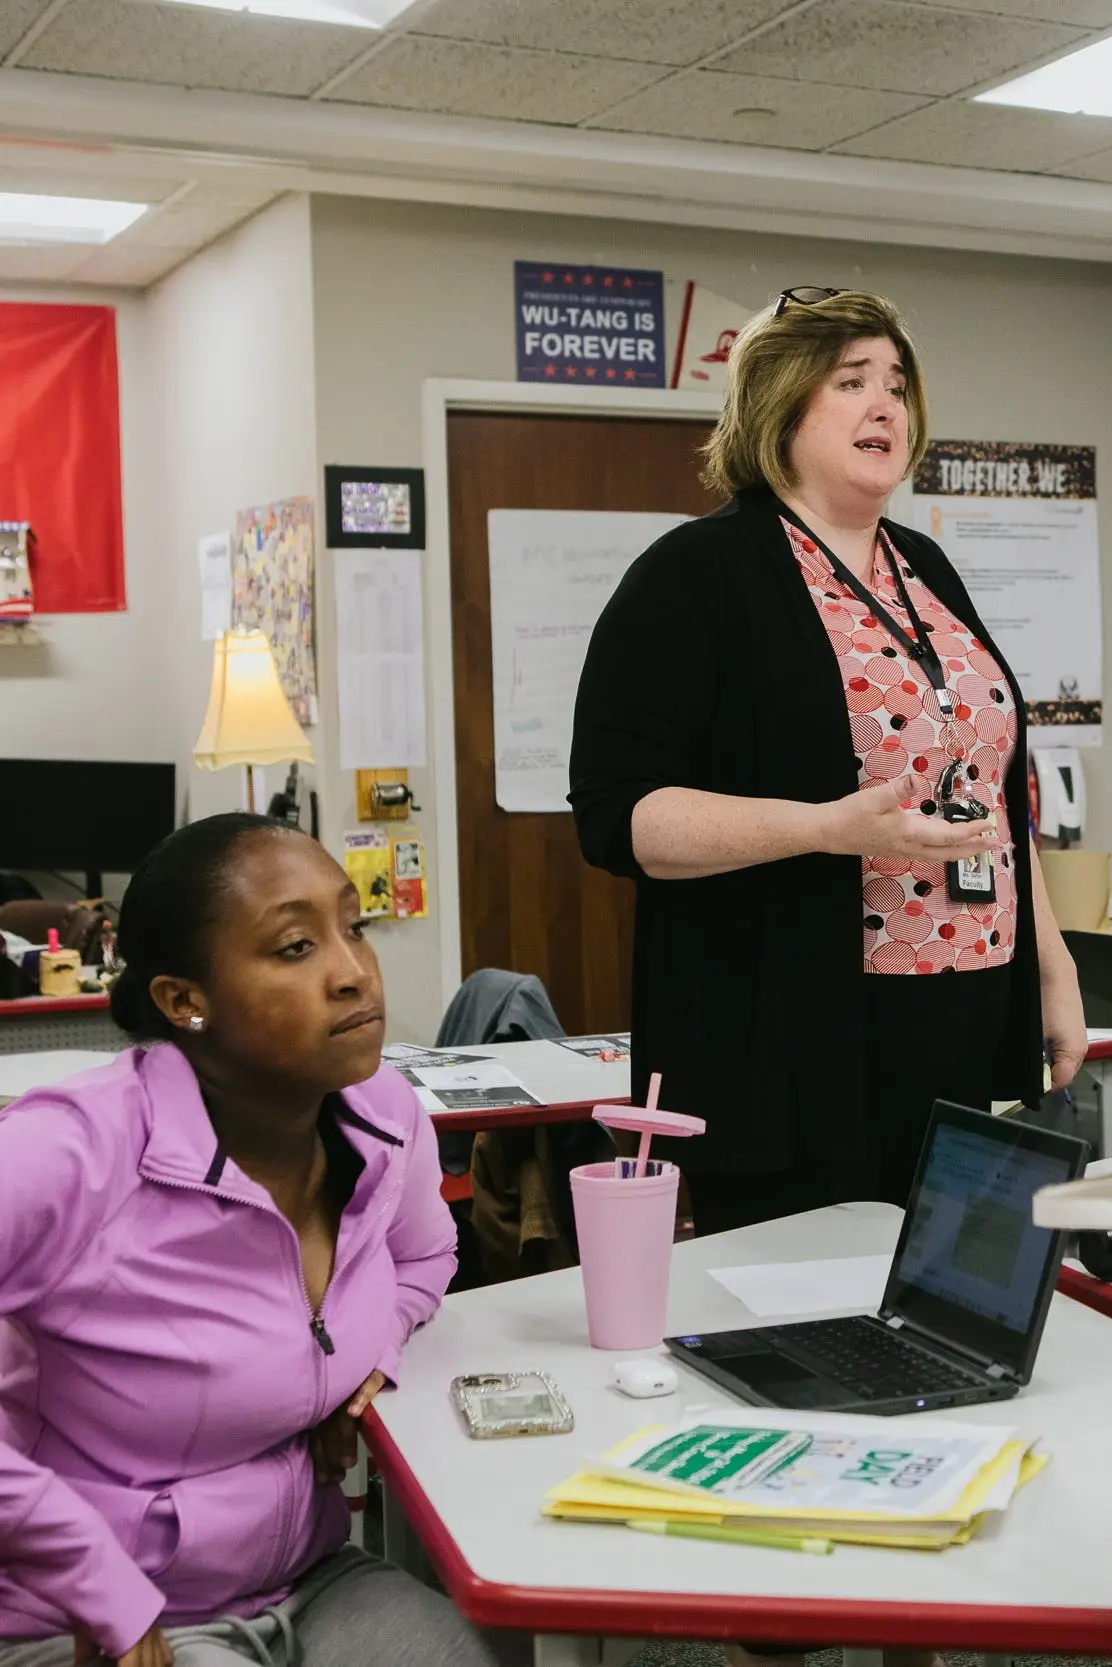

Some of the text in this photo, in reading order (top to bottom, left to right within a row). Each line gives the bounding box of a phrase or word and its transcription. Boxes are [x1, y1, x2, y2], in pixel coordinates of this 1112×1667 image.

[522, 305, 656, 332] WU-TANG IS
[524, 333, 657, 363] FOREVER
[1038, 460, 1067, 493] WE
[962, 879, 984, 890] Faculty
[838, 1450, 913, 1486] DAY
[889, 1454, 945, 1489] FIELD
